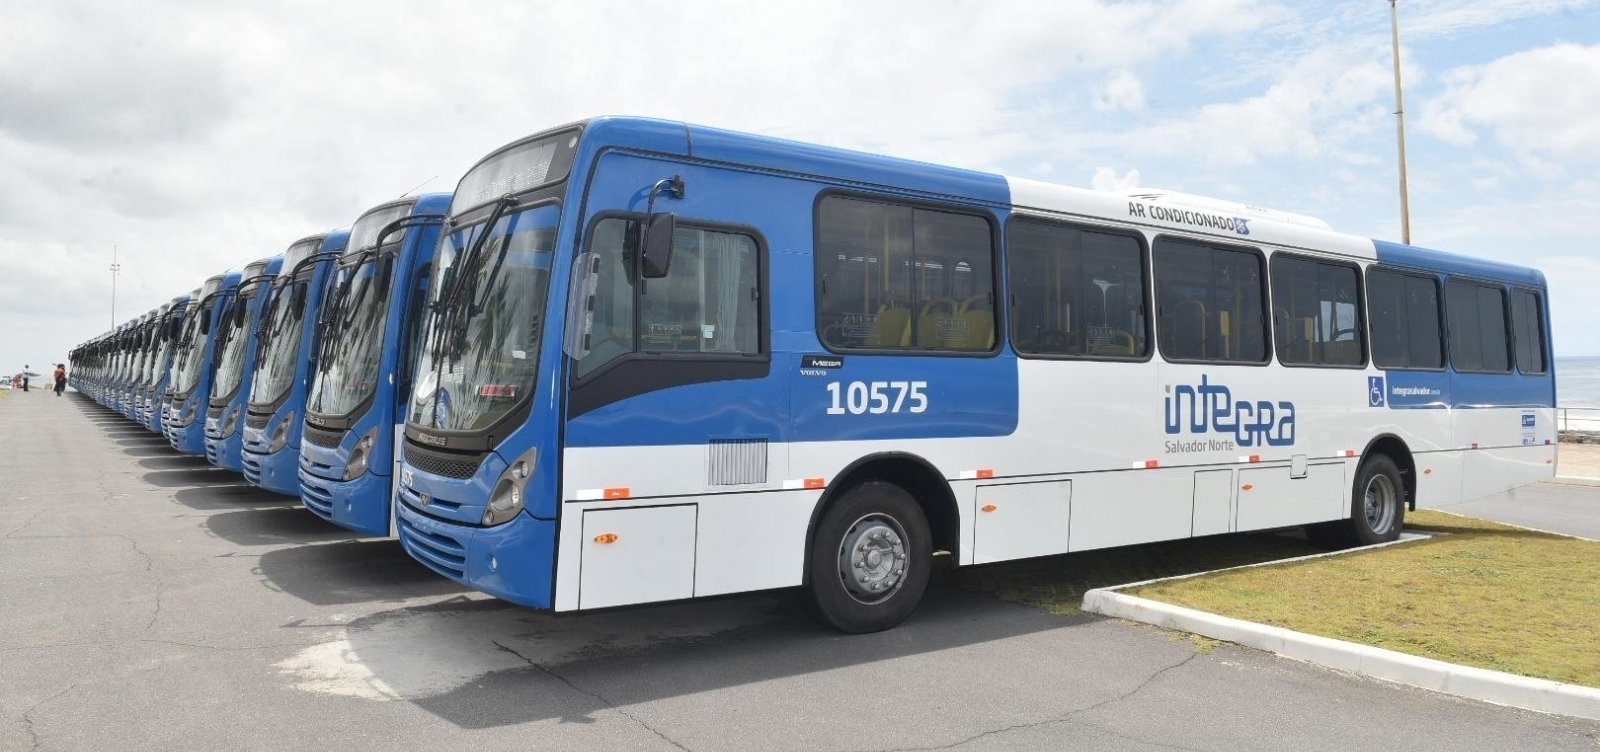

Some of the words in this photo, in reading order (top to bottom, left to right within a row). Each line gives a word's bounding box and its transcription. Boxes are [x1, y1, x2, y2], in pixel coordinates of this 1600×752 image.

[1128, 201, 1146, 217] AR
[1149, 205, 1235, 230] CONDICIONADO
[827, 381, 928, 415] 10575
[1165, 440, 1207, 454] Salvador
[1208, 439, 1234, 451] Norte
